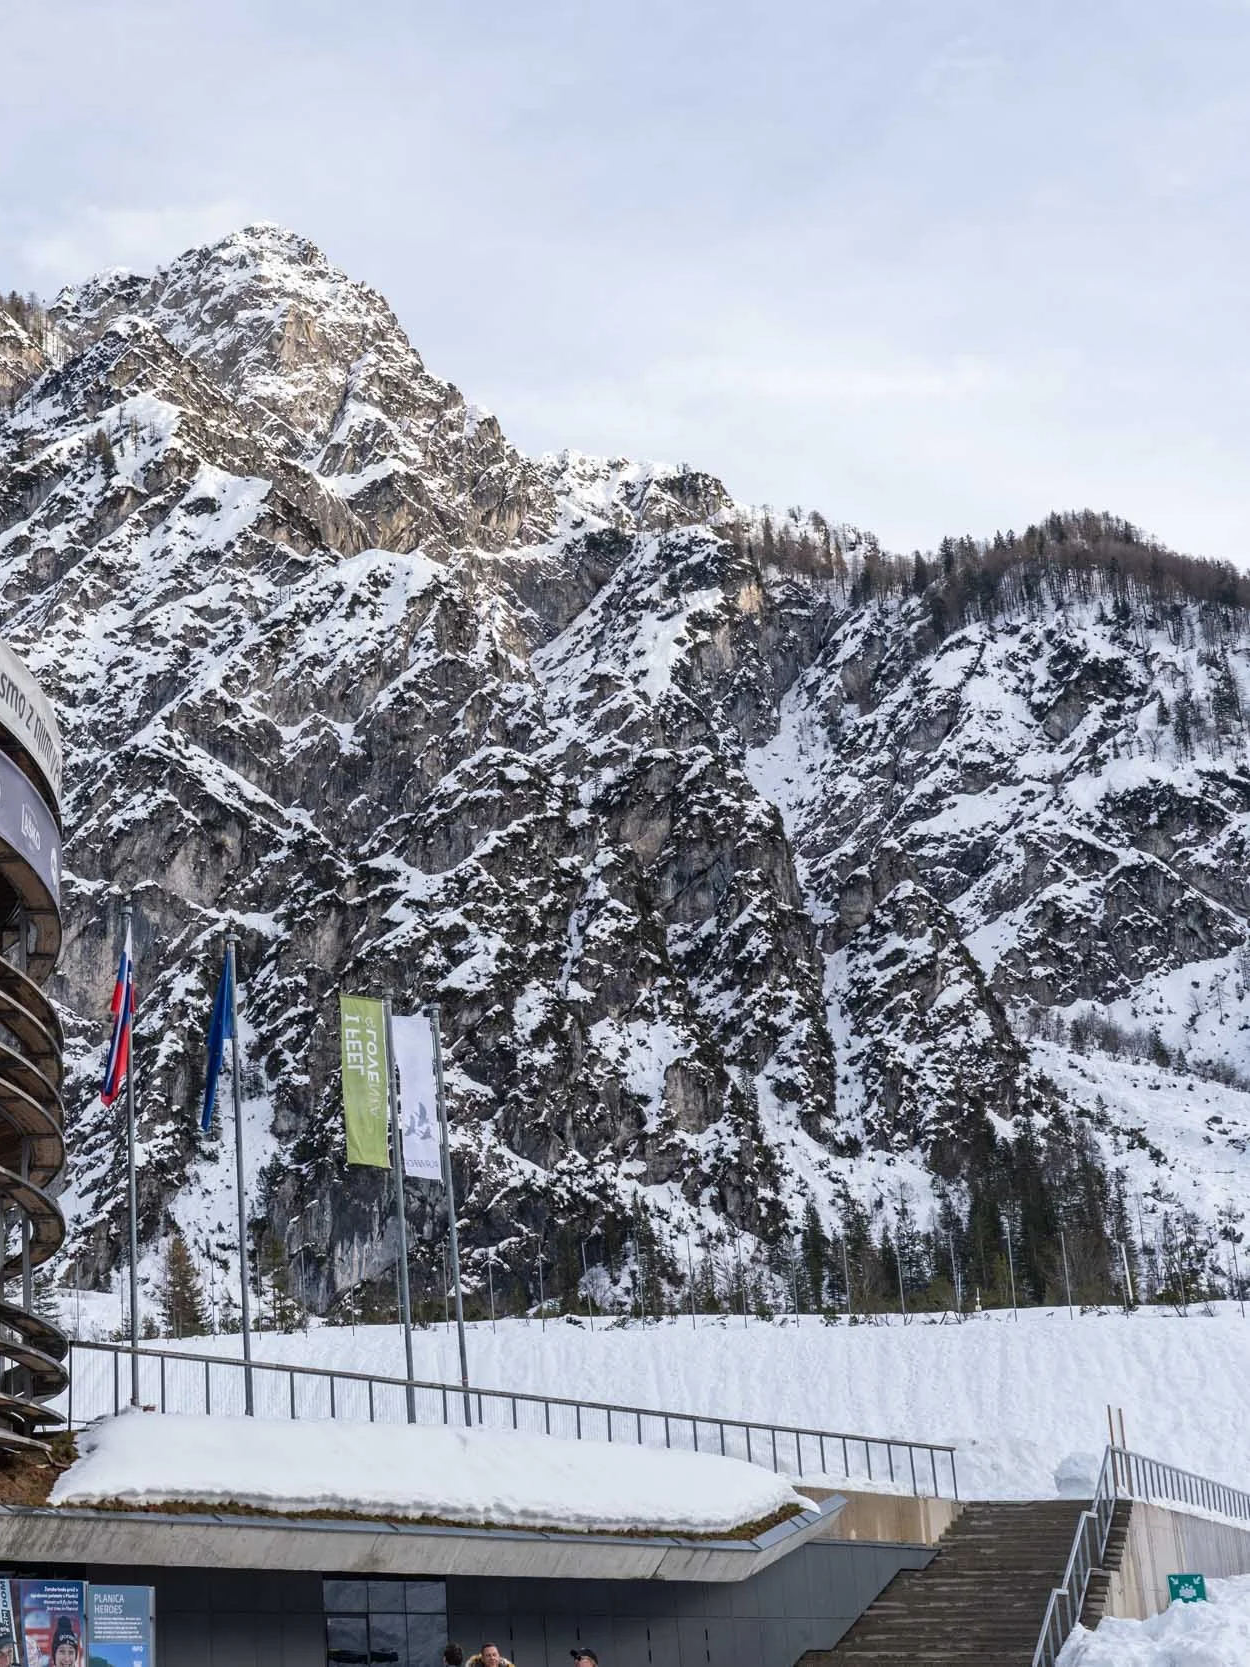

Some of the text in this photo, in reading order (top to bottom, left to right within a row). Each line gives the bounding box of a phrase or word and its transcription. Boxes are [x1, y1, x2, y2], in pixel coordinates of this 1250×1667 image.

[25, 703, 34, 731] z
[93, 1593, 125, 1604] PLANICA
[93, 1604, 124, 1615] HEROES
